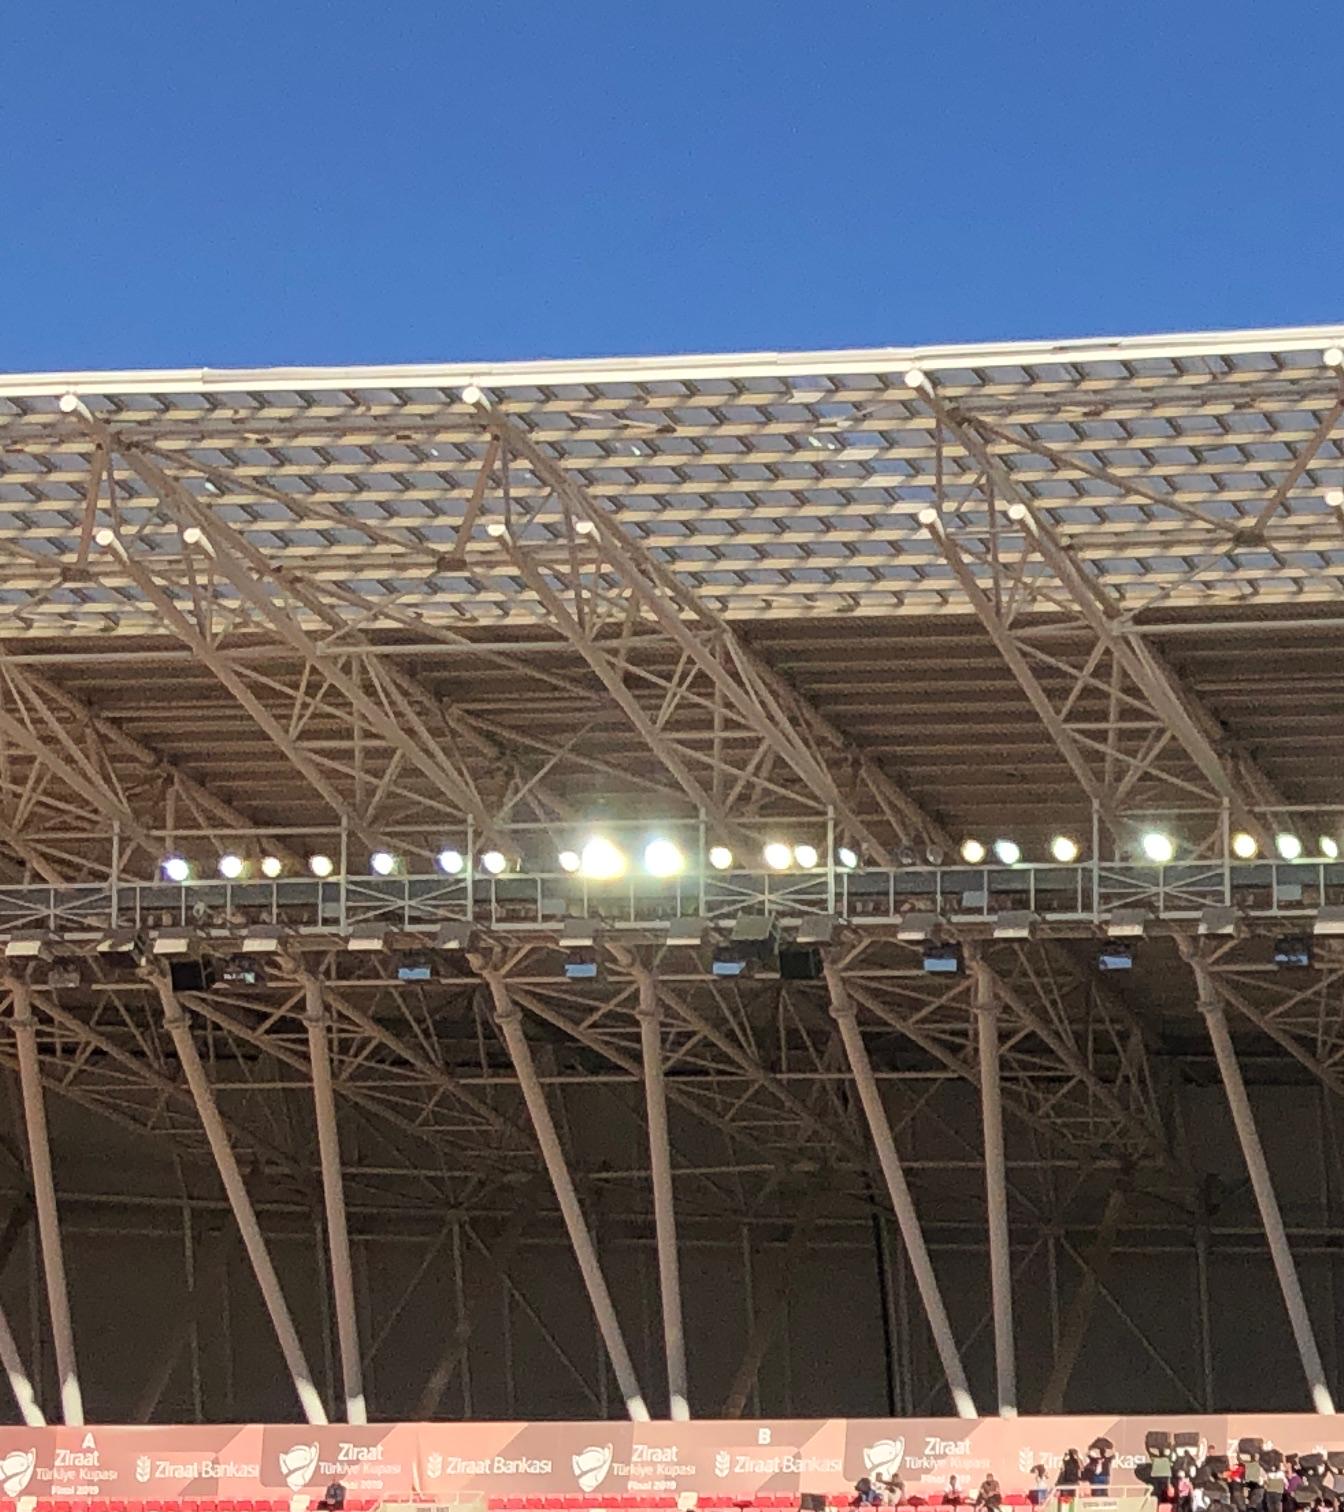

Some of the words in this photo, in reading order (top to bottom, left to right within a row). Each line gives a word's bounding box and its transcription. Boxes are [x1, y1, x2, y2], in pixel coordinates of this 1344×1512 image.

[81, 1432, 96, 1449] A
[758, 1428, 770, 1445] B
[924, 1436, 971, 1456] Ziraat
[54, 1448, 100, 1467] Ziraat
[337, 1442, 384, 1461] Ziraat
[632, 1444, 678, 1463] Ziraat
[155, 1460, 199, 1478] Ziraat
[446, 1456, 492, 1475] Ziraat
[493, 1455, 552, 1475] Bankası
[734, 1455, 781, 1474] Ziraat
